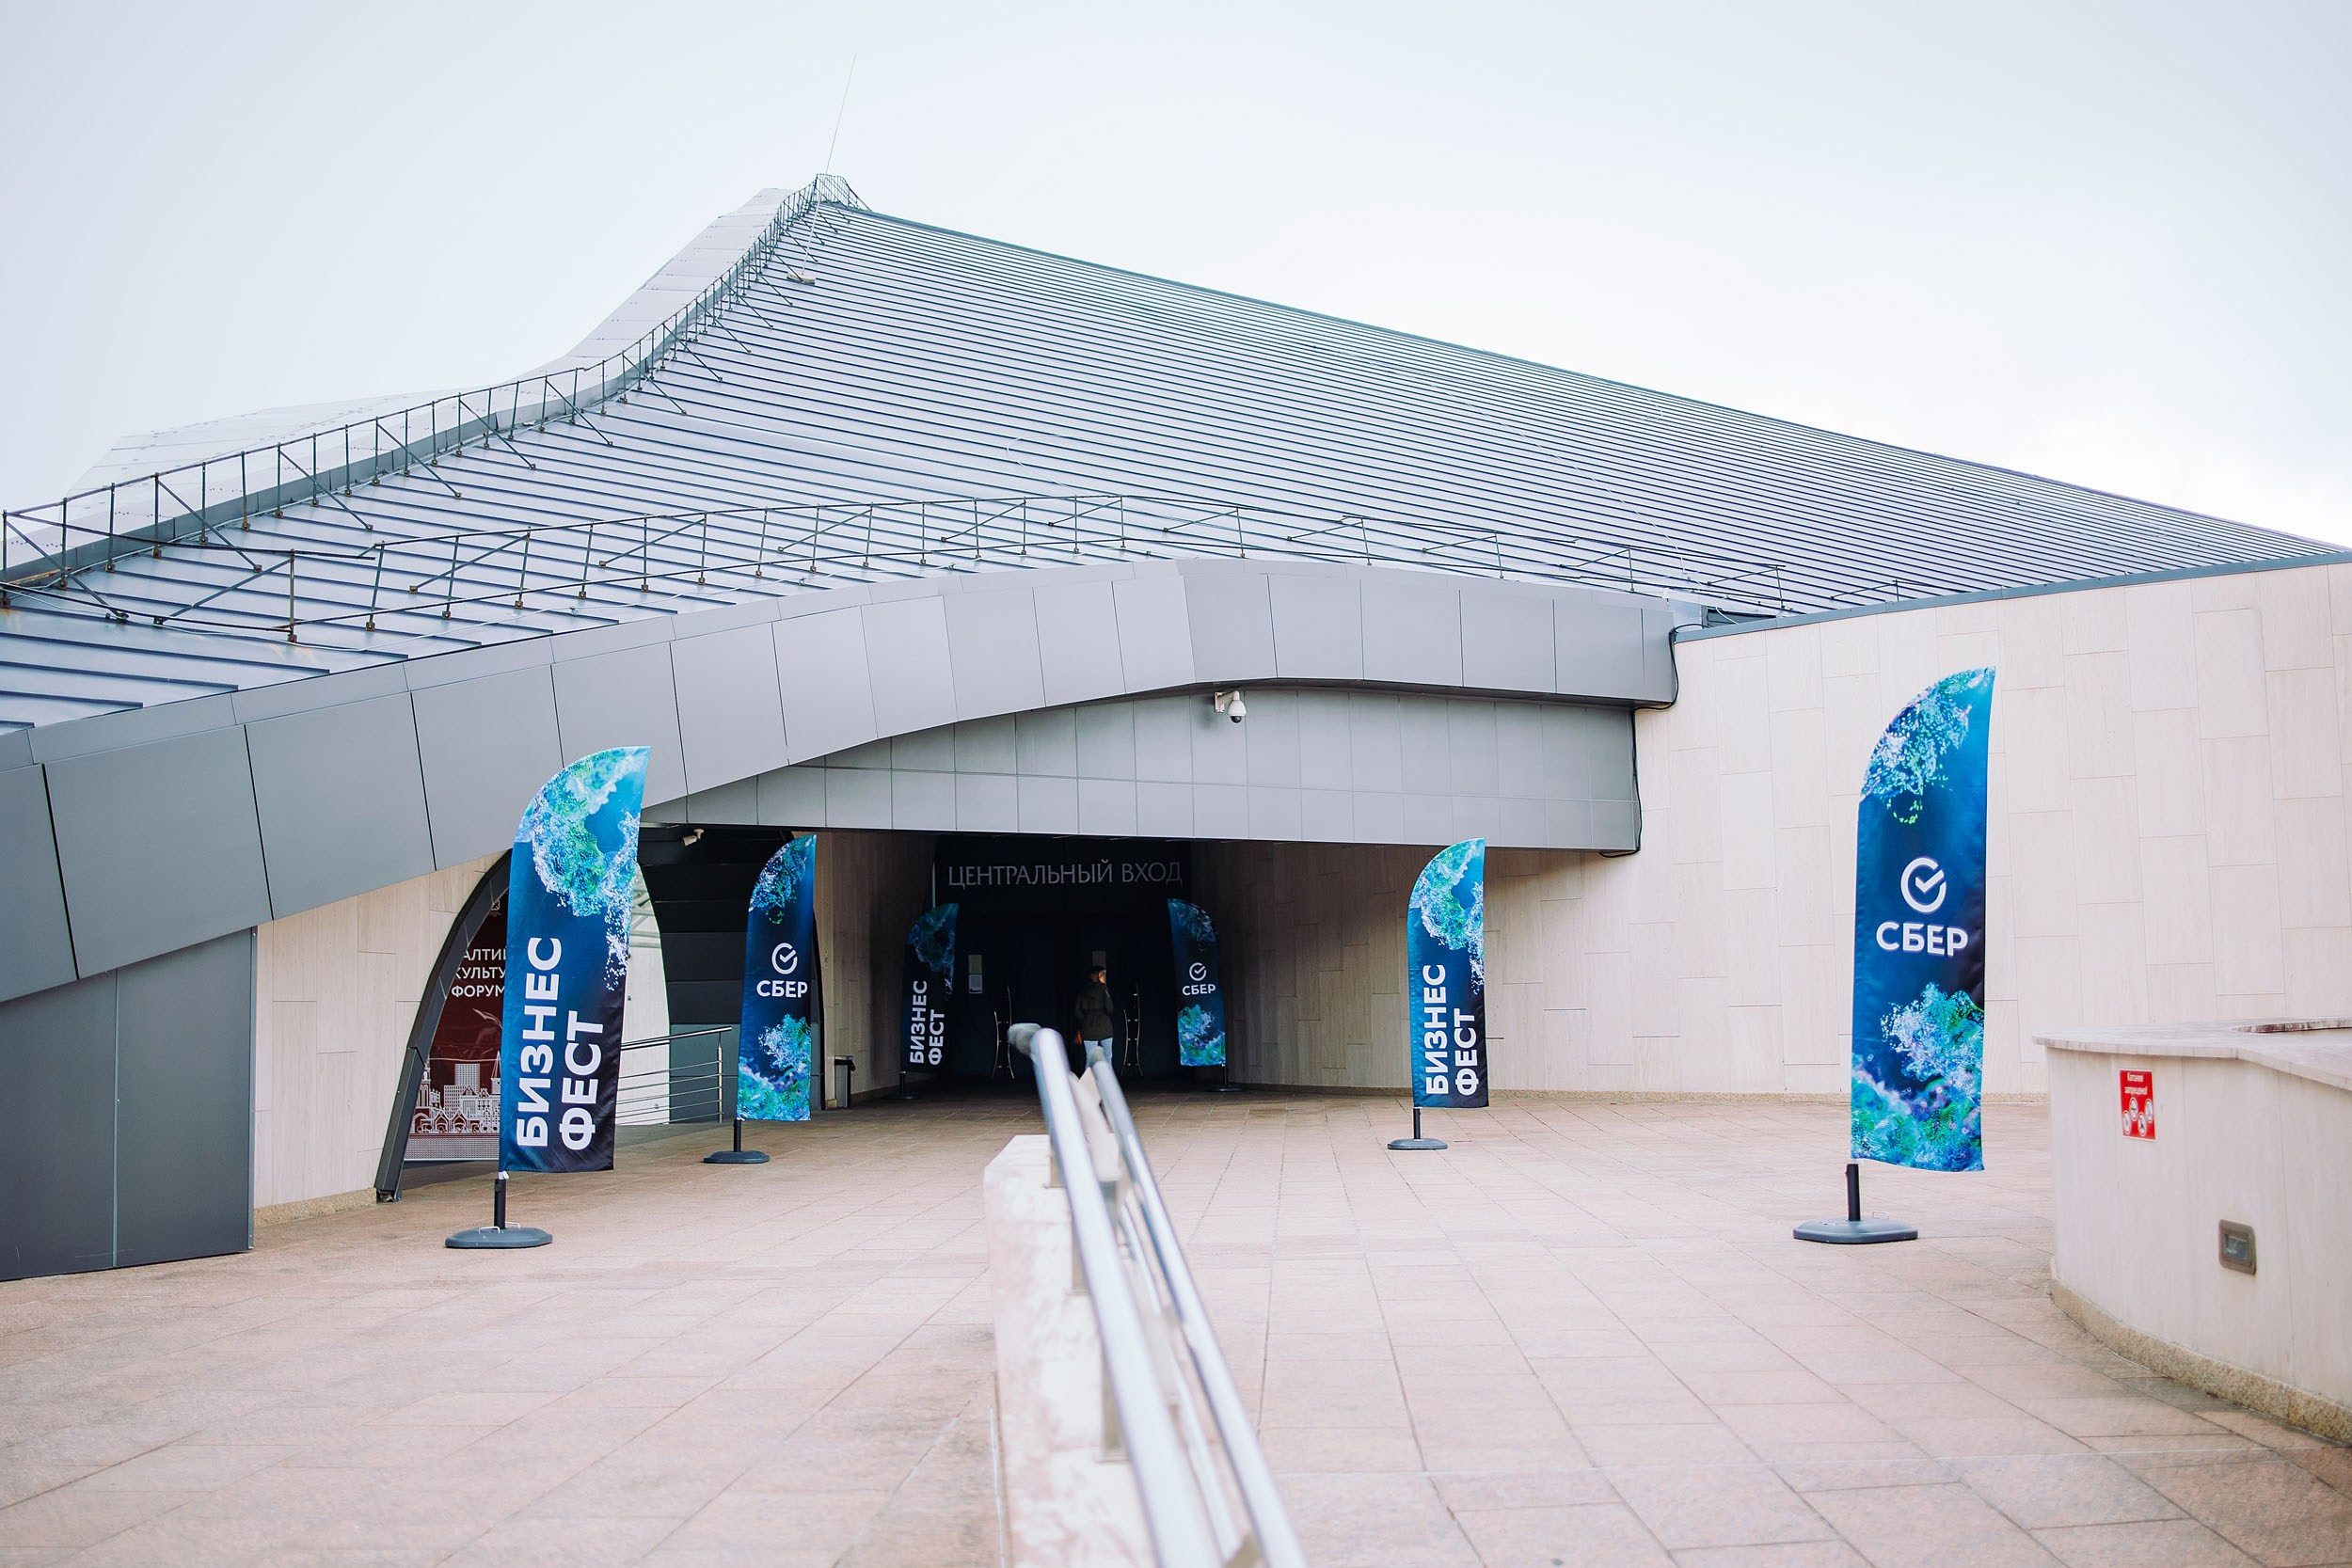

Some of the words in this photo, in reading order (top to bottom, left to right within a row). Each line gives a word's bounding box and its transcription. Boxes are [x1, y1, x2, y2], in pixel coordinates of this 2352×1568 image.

[948, 859, 1113, 890] ЦЕНТРАЛЬНЫЙ
[1121, 862, 1183, 884] ВХОД
[1876, 921, 1969, 957] СБЕР
[756, 979, 808, 998] СБЕР
[909, 980, 929, 1064] БИЗНЕС
[1182, 982, 1216, 996] СБЕР
[516, 937, 563, 1148] БИЗНЕС
[928, 1009, 945, 1065] ФЕСТ
[1422, 964, 1449, 1095] БИЗНЕС
[1454, 1007, 1480, 1096] ФЕСТ
[559, 1010, 604, 1150] ФЕСТ
